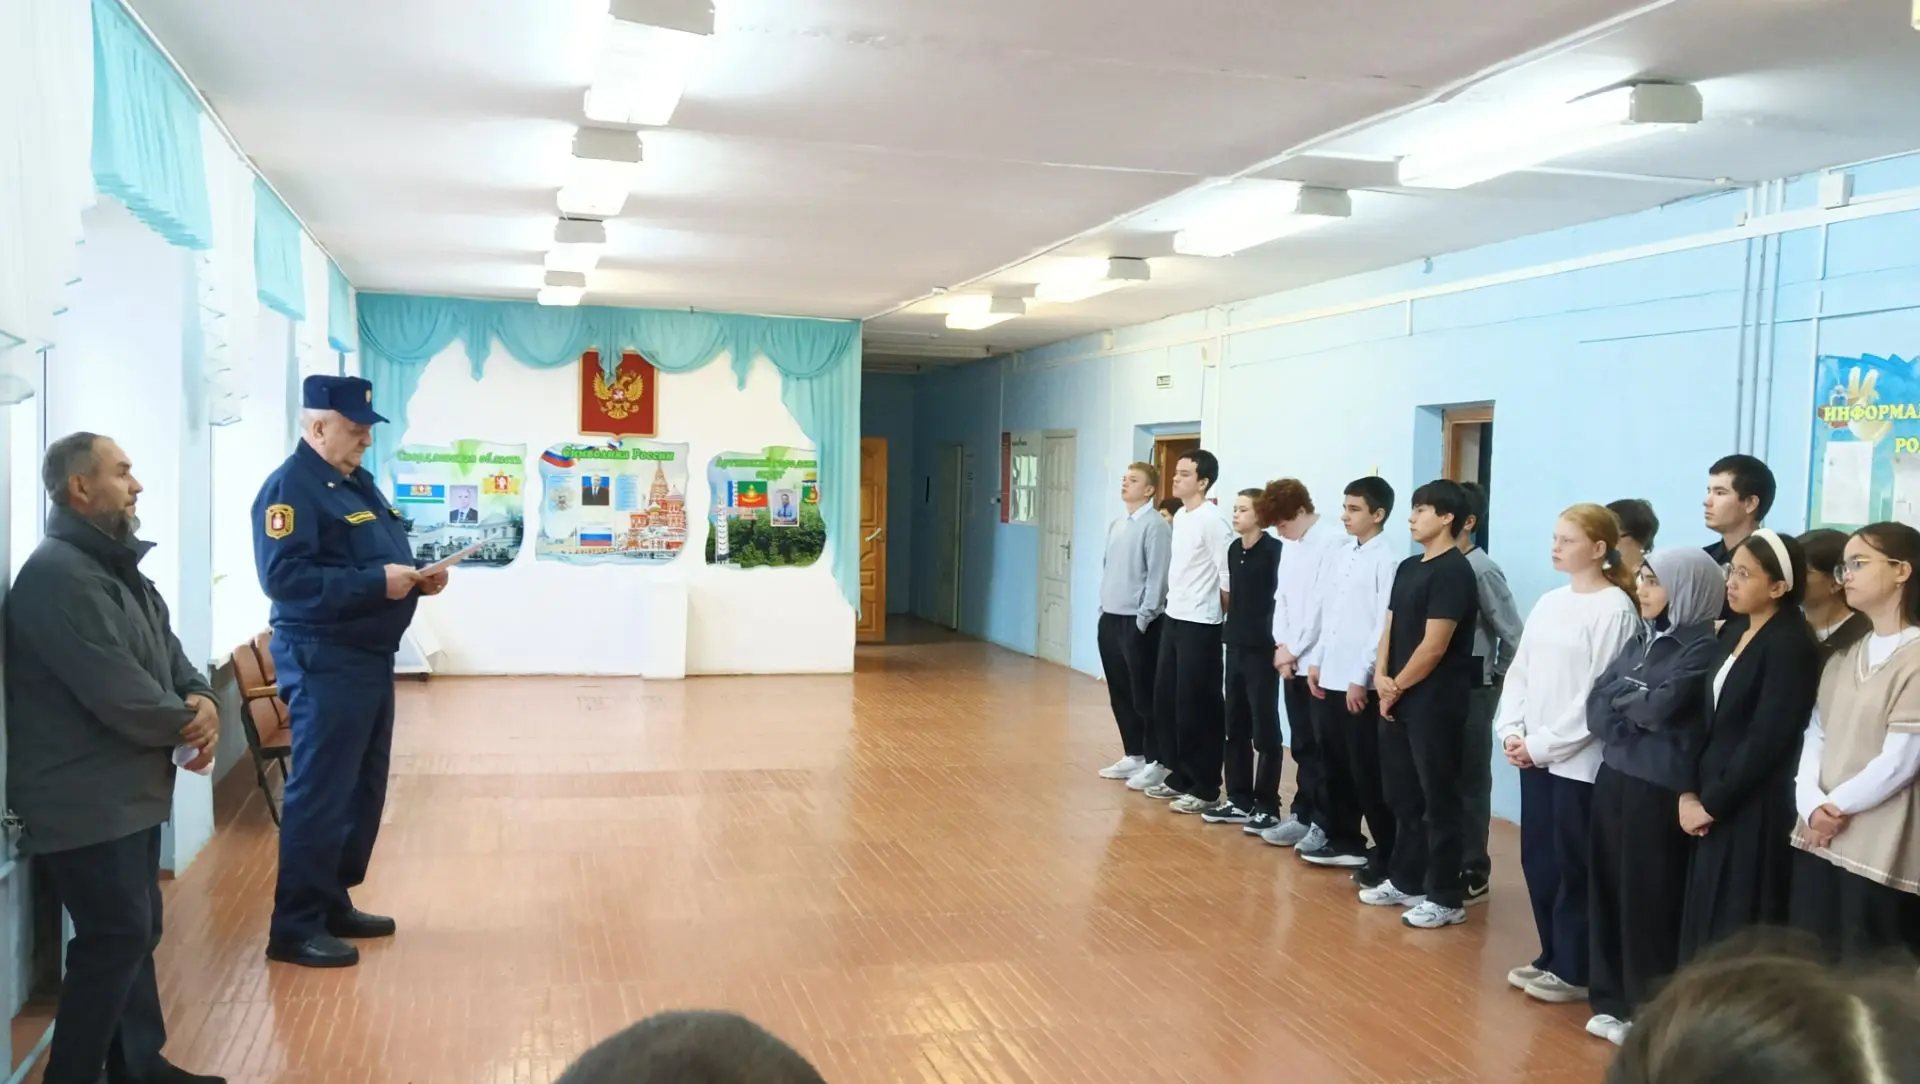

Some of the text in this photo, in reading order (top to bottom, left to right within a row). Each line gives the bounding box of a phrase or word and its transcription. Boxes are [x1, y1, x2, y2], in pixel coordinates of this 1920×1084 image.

[1823, 403, 1920, 423] ИНФОРМА
[1894, 436, 1920, 454] РО
[632, 448, 675, 461] России
